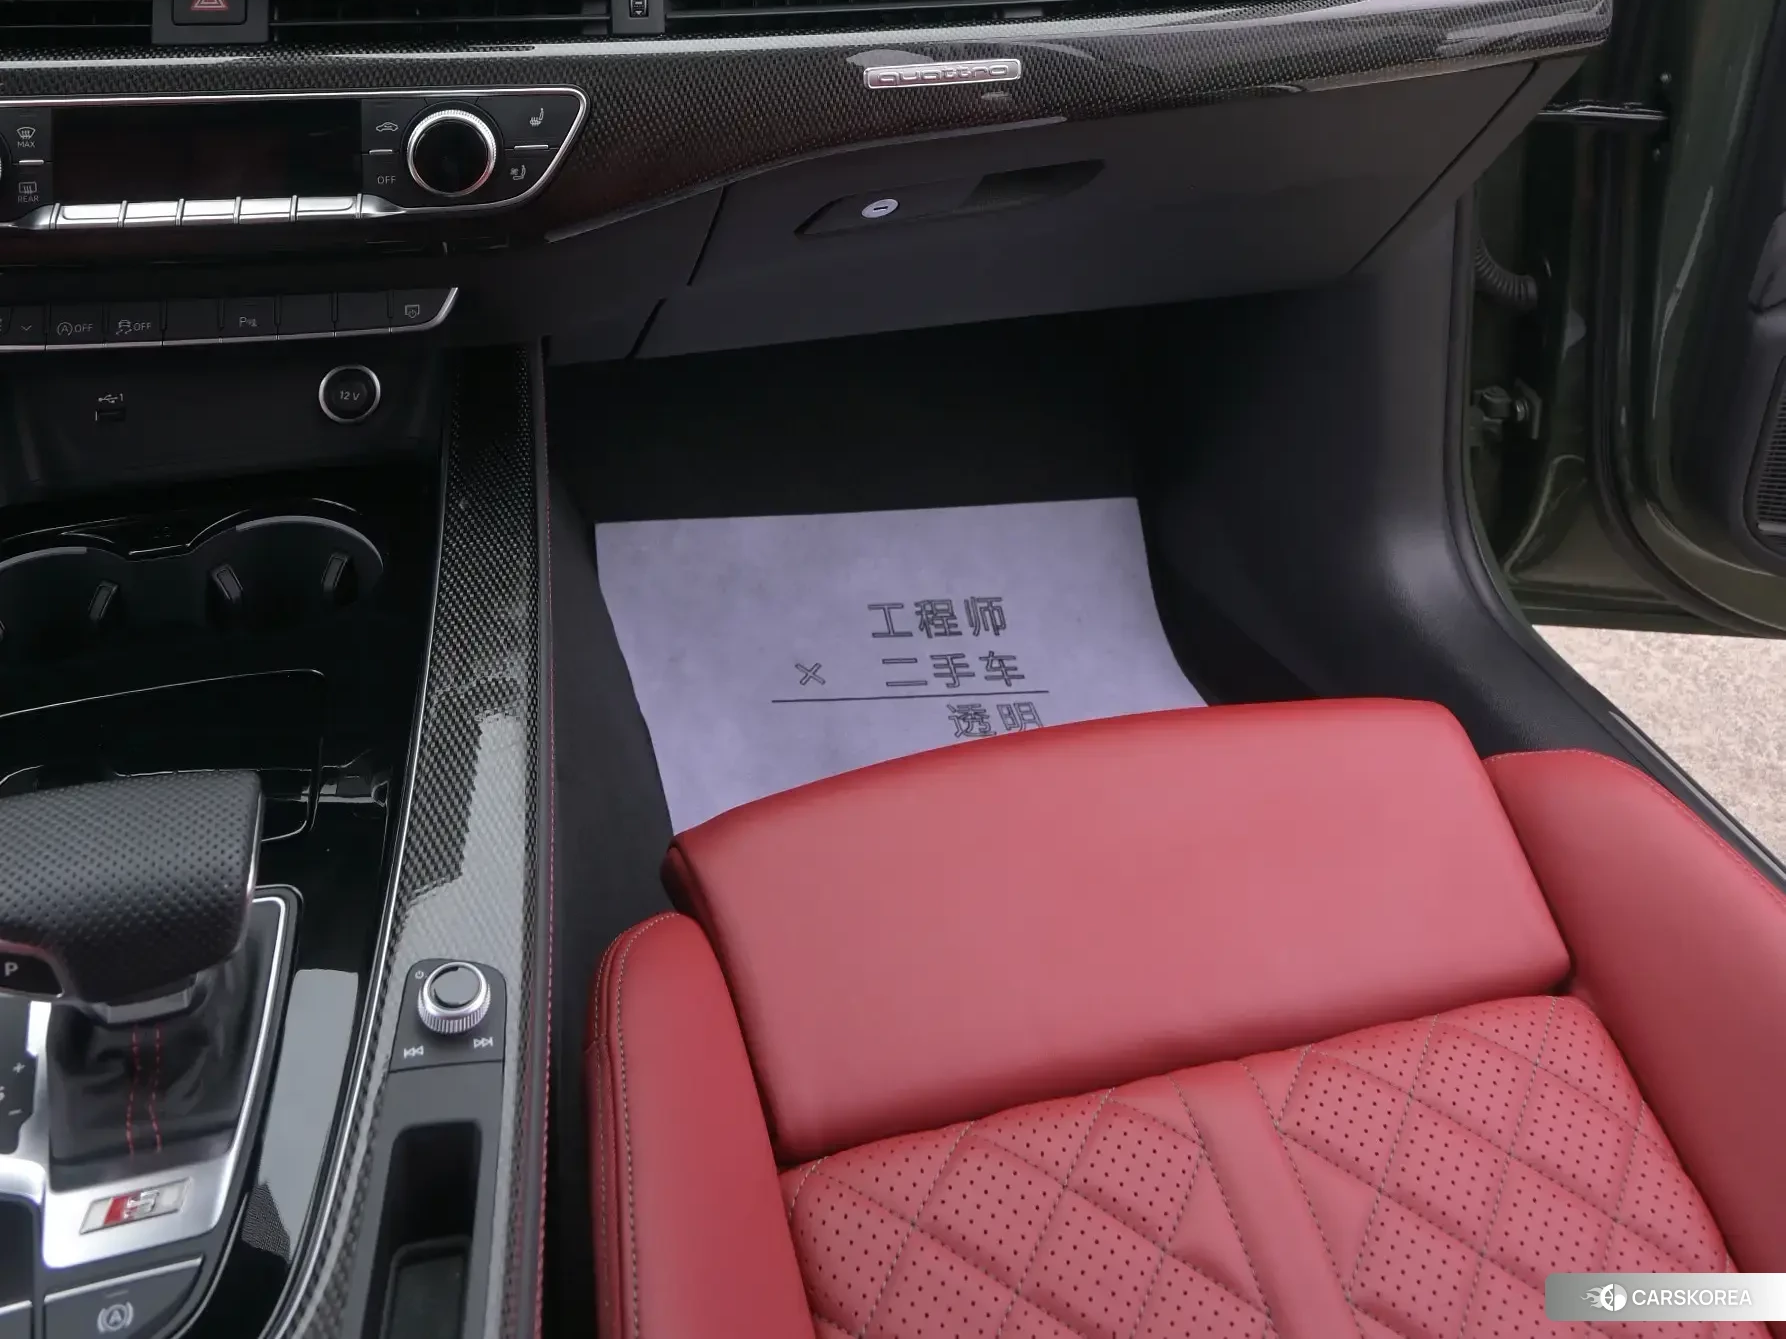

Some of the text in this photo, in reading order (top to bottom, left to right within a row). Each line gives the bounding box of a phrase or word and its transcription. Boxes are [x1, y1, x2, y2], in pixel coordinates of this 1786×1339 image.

[877, 64, 1009, 86] quattro
[377, 175, 396, 185] OFF
[17, 195, 39, 203] REAR
[74, 324, 93, 333] OFF
[133, 322, 151, 331] OFF
[340, 390, 350, 400] 12
[867, 596, 1007, 639] 工程师
[882, 651, 1025, 689] 二手车
[946, 701, 1043, 738] 透明
[5, 961, 19, 977] P
